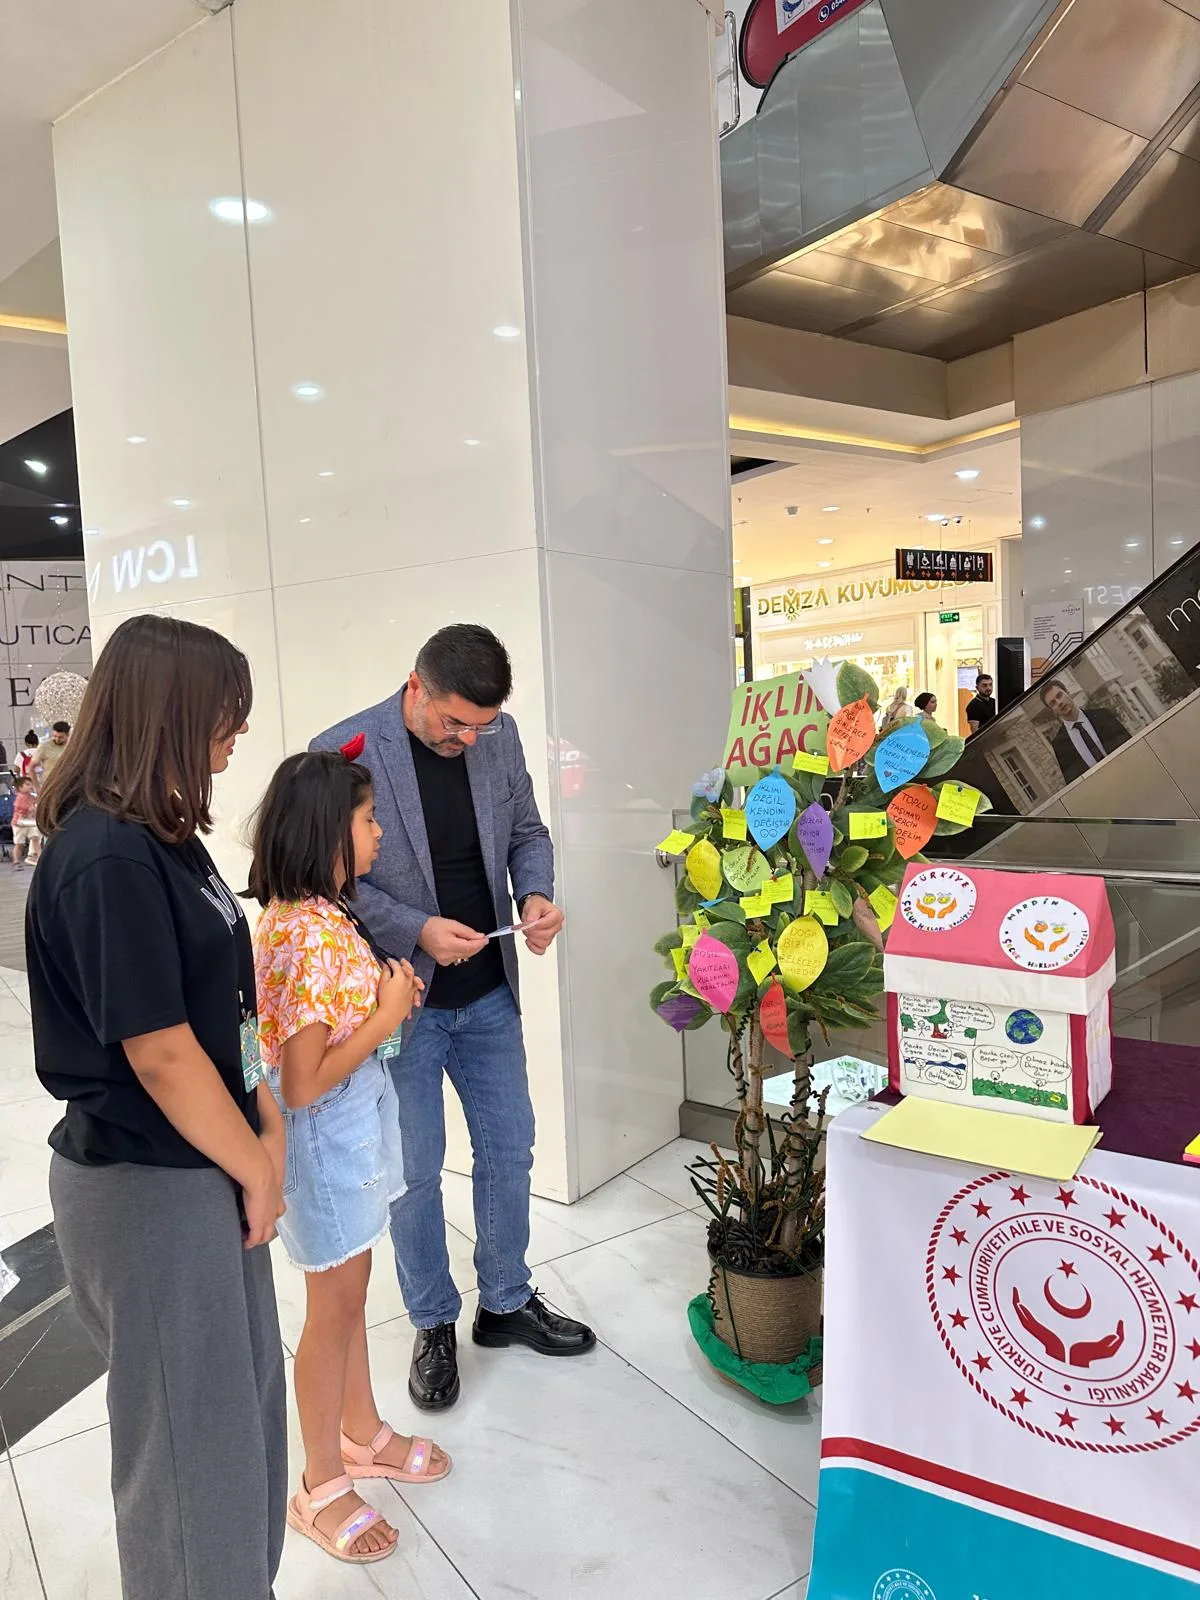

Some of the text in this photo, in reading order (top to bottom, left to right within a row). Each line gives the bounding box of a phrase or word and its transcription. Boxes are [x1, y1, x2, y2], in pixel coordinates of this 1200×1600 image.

[902, 792, 929, 811] TOPLU
[910, 871, 970, 888] TÜRKİYE
[1007, 897, 1059, 921] MARDİN
[975, 1219, 1169, 1404] TÜRKİYE CUMHURİYETİ AİLE VE SOSYAL HİZMETLER BAKANLIĞI
